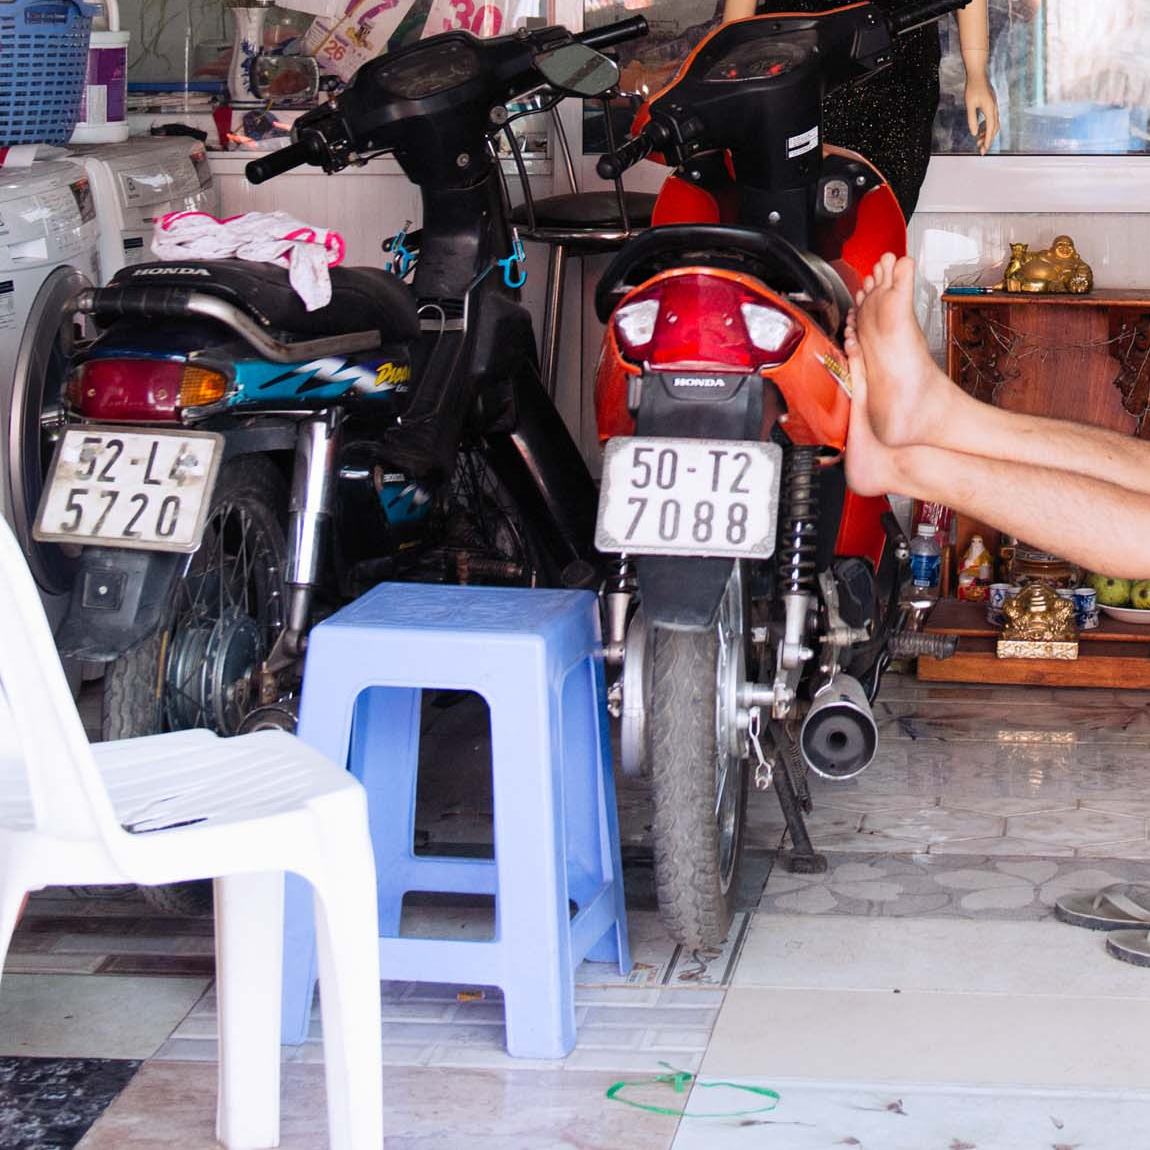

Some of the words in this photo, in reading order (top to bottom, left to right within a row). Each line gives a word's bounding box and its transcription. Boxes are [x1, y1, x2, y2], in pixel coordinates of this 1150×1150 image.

[324, 40, 346, 61] 26
[132, 268, 212, 276] HONDA
[674, 377, 726, 387] HONDA
[631, 447, 752, 494] 50-T2
[61, 488, 181, 539] 5720
[624, 497, 748, 545] 7088
